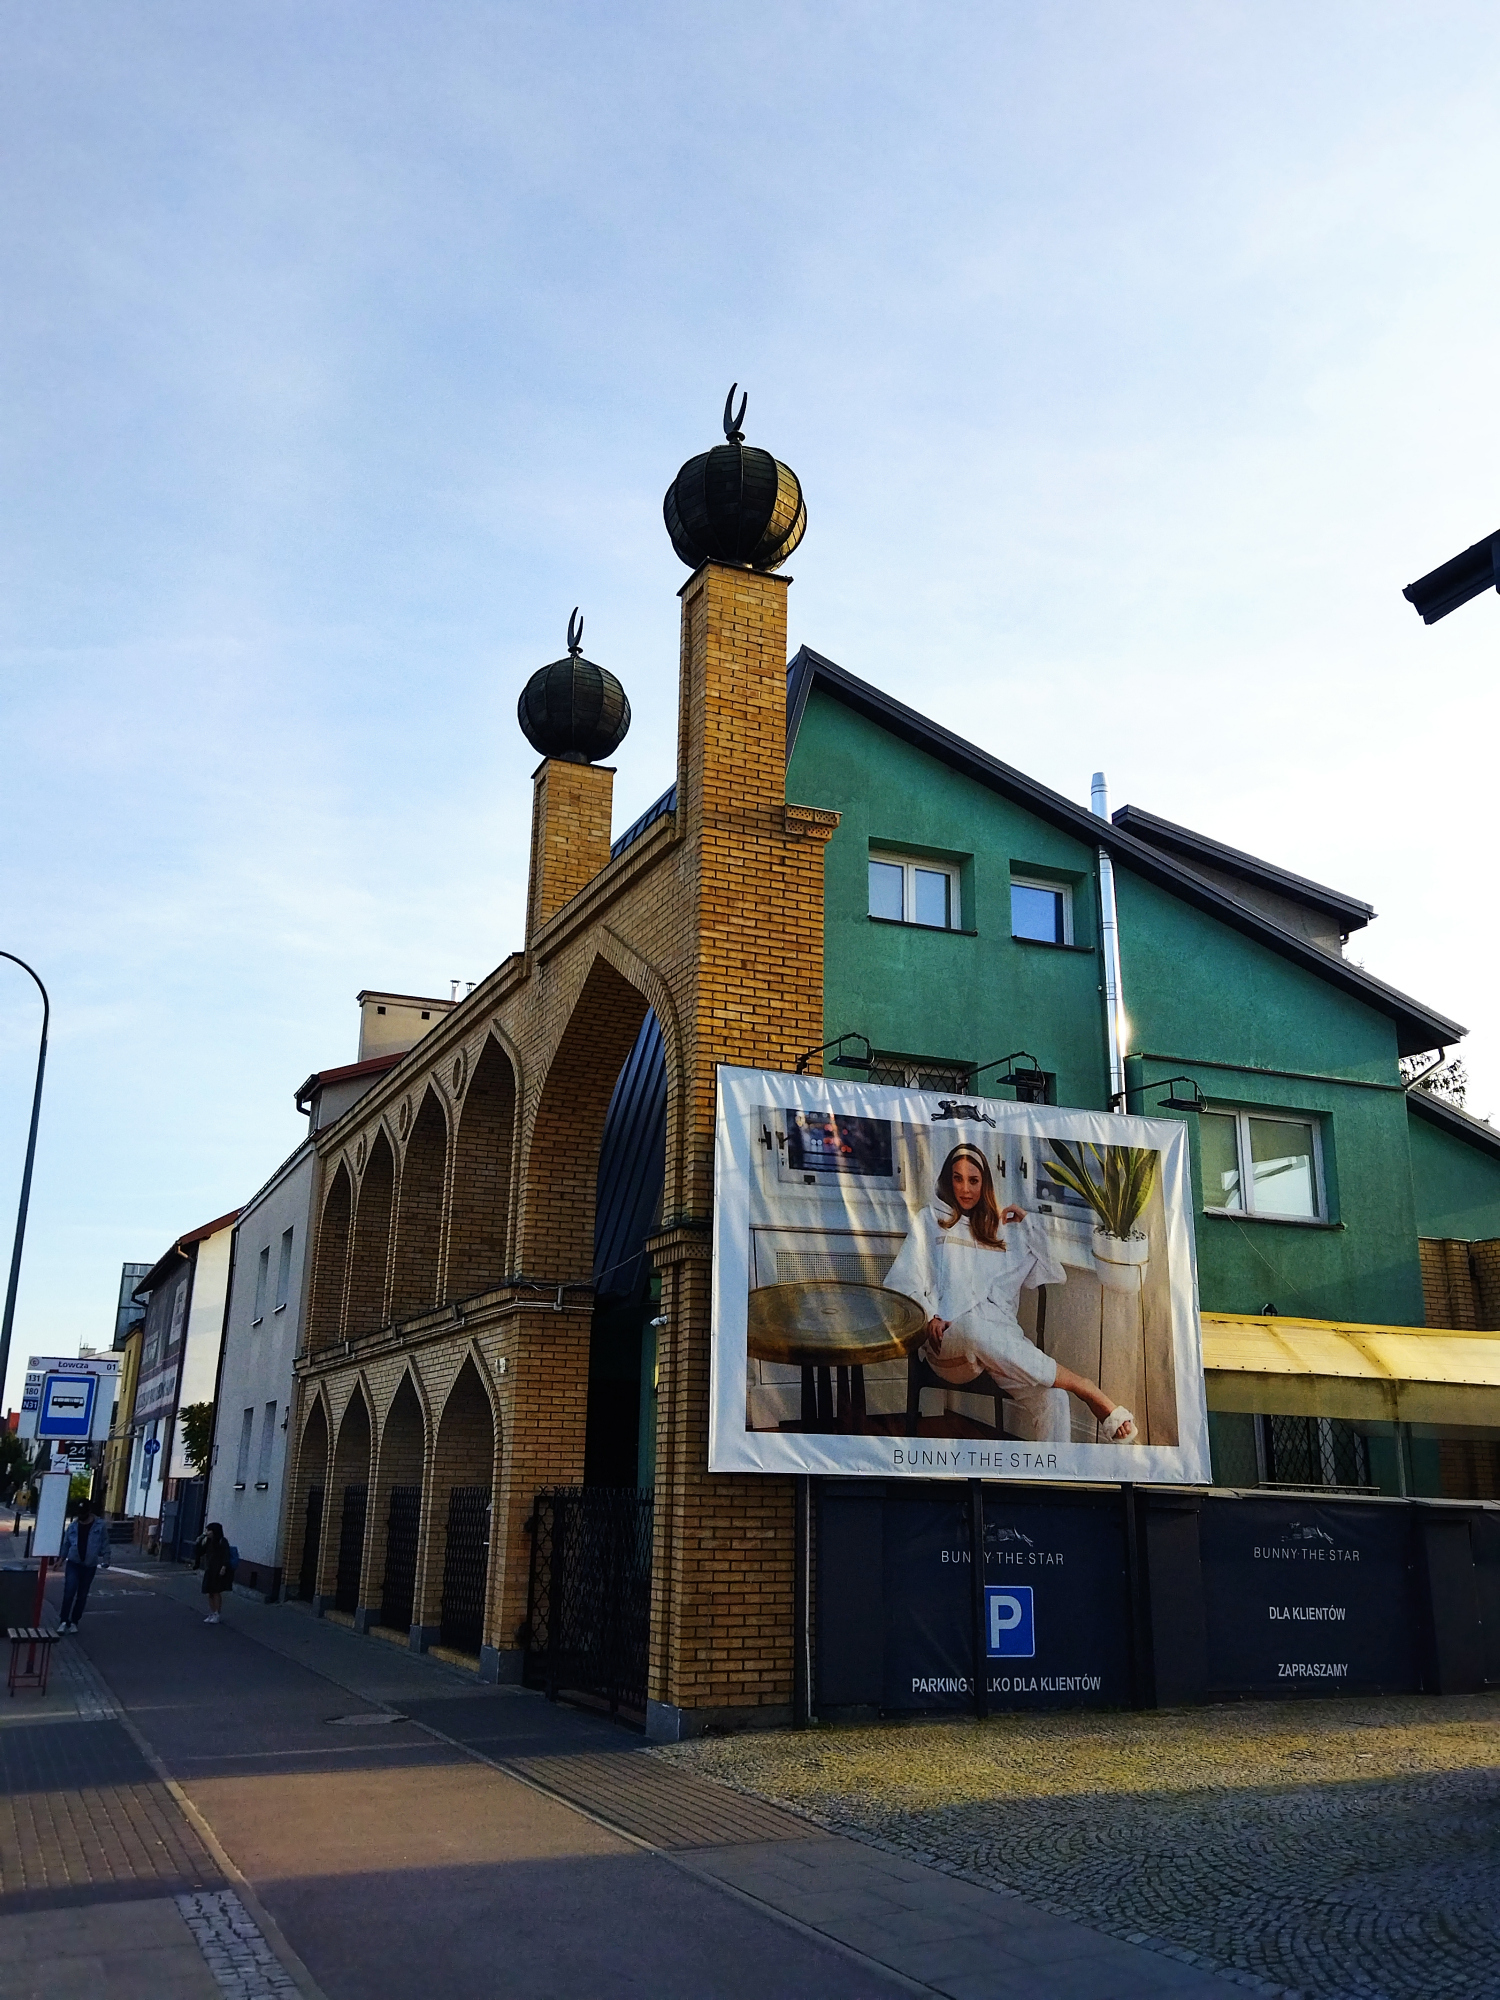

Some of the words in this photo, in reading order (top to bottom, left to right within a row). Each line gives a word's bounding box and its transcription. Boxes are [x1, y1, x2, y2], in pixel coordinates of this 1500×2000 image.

[58, 1361, 89, 1369] Łowcza
[106, 1363, 116, 1371] 01
[28, 1374, 40, 1382] 131
[25, 1387, 39, 1395] 180
[22, 1400, 38, 1409] N31
[941, 1550, 992, 1563] BUNY
[1269, 1606, 1291, 1619] DLA
[1292, 1604, 1346, 1620] KLIENTÓW
[990, 1595, 1022, 1649] P
[1278, 1664, 1348, 1676] ZAPRASZAMY
[912, 1677, 967, 1692] PARKING
[969, 1677, 1010, 1692] TLKO
[1013, 1677, 1038, 1691] DLA
[1040, 1673, 1101, 1691] KLIENTÓW
